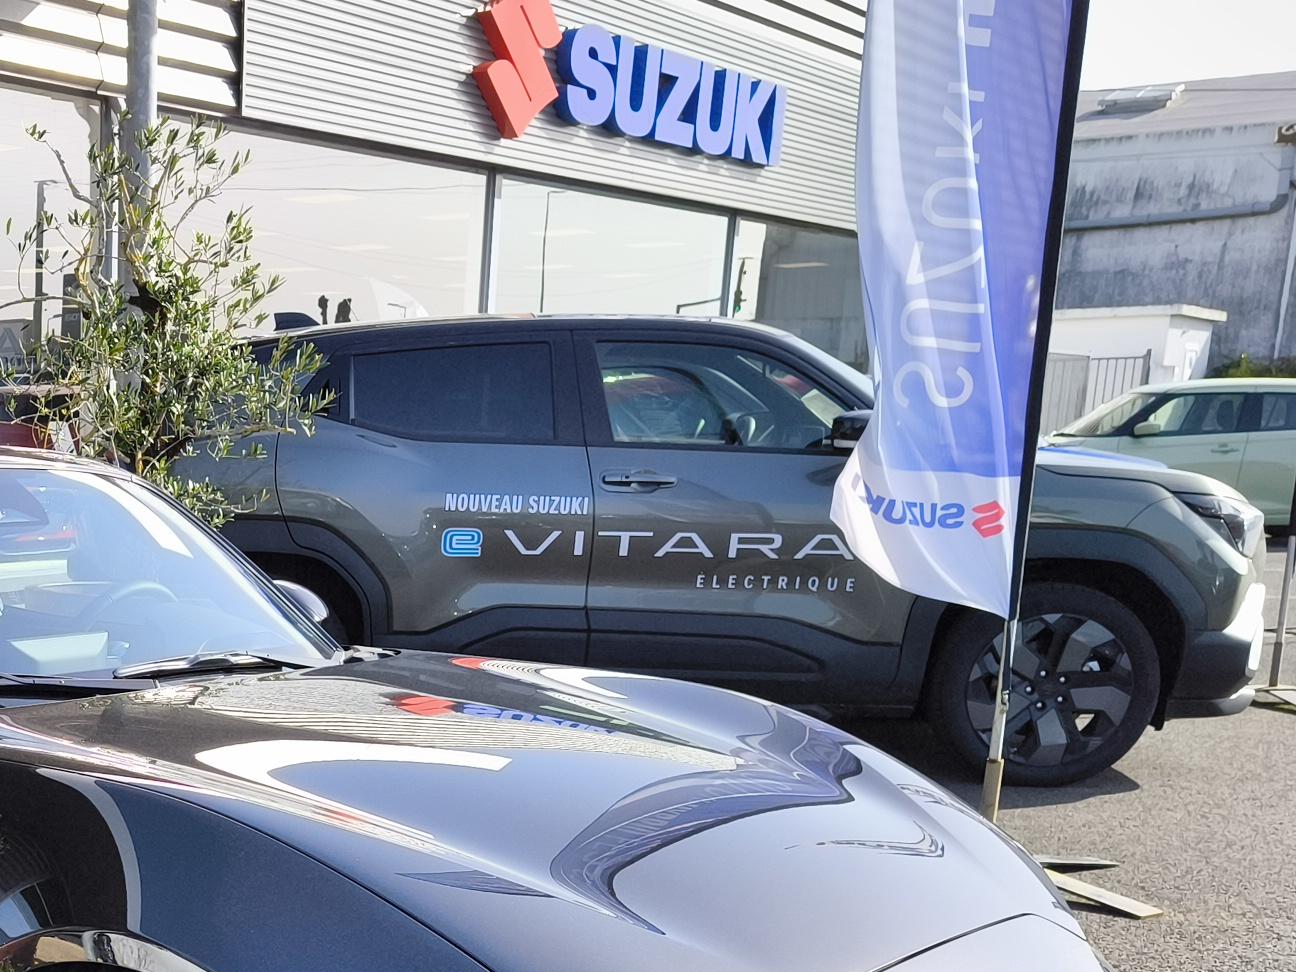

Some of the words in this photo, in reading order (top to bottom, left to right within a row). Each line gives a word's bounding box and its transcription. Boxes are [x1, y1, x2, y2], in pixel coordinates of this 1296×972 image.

[559, 23, 788, 167] SUZUKI
[445, 493, 523, 513] NOUVEAU
[527, 496, 589, 515] SUZUKI
[504, 530, 855, 561] VITARA
